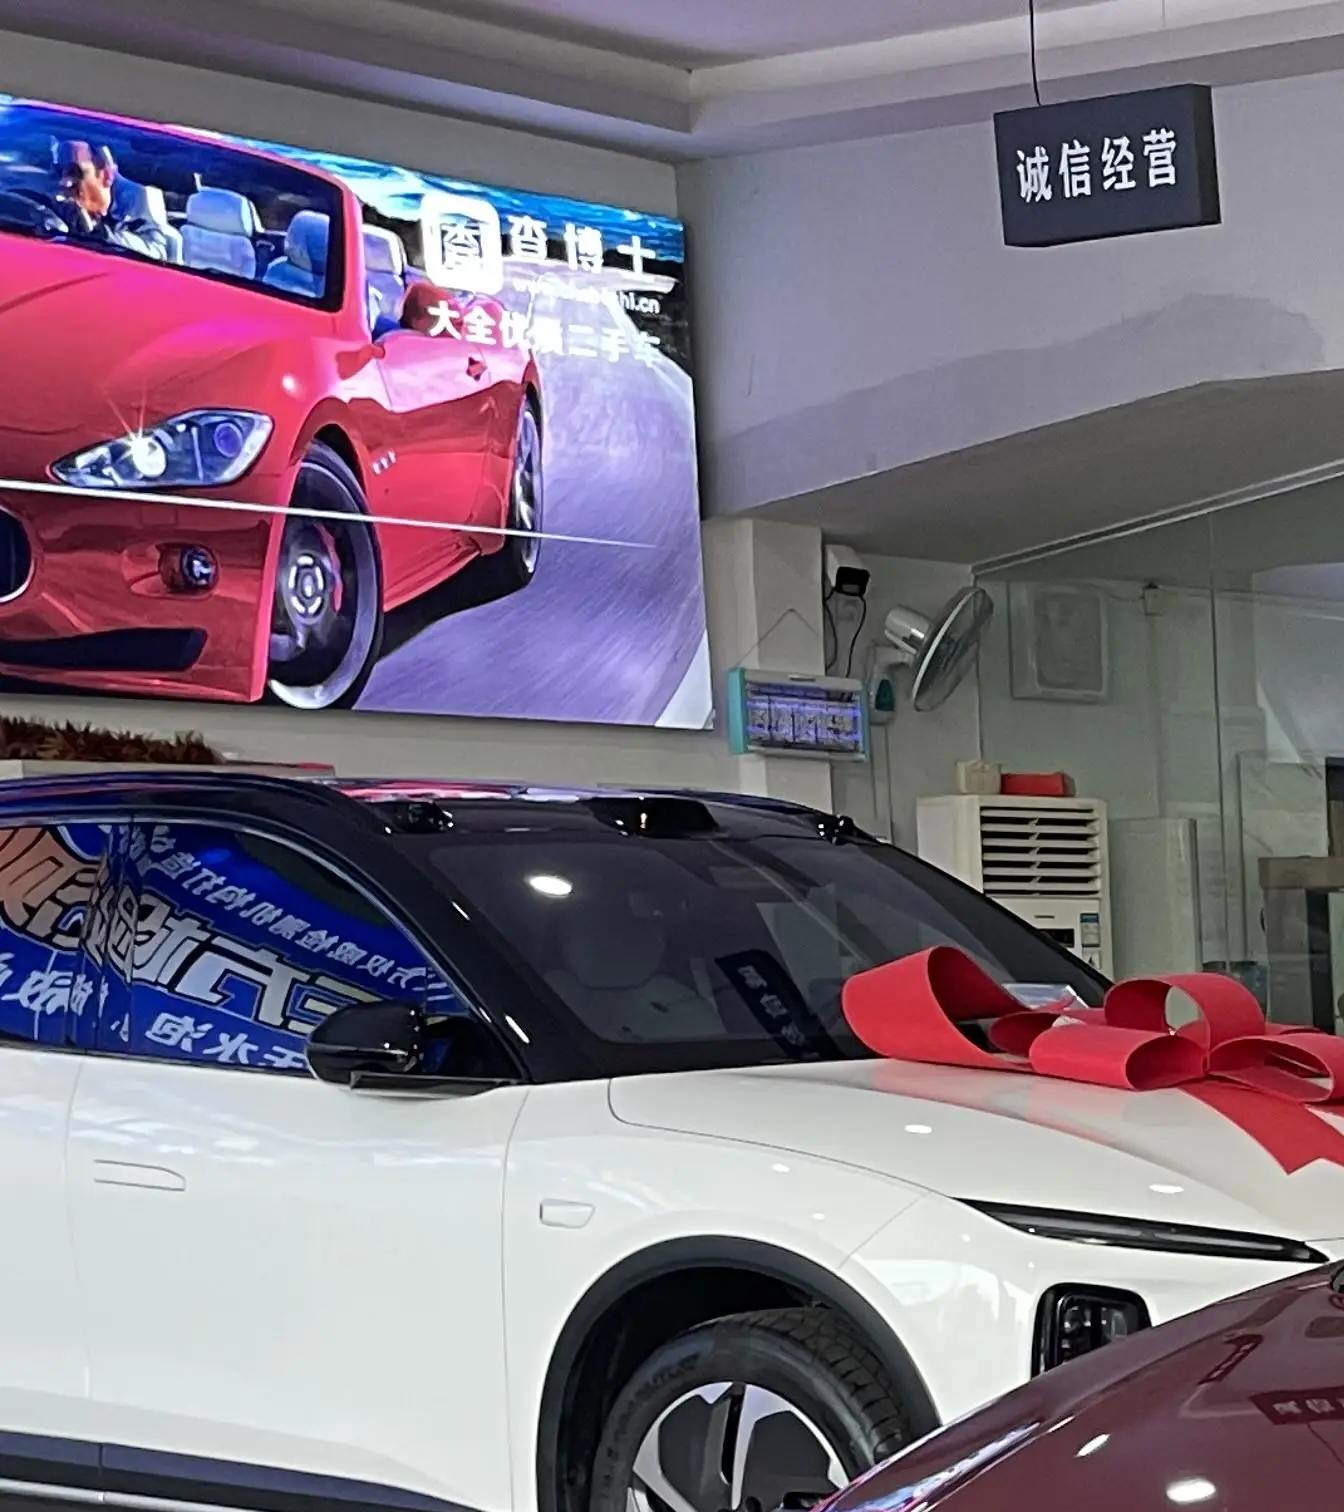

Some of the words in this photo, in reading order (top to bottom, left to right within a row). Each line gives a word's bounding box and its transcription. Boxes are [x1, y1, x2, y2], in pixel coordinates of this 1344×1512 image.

[1016, 128, 1177, 203] 诚信经营
[506, 215, 656, 279] 查博士
